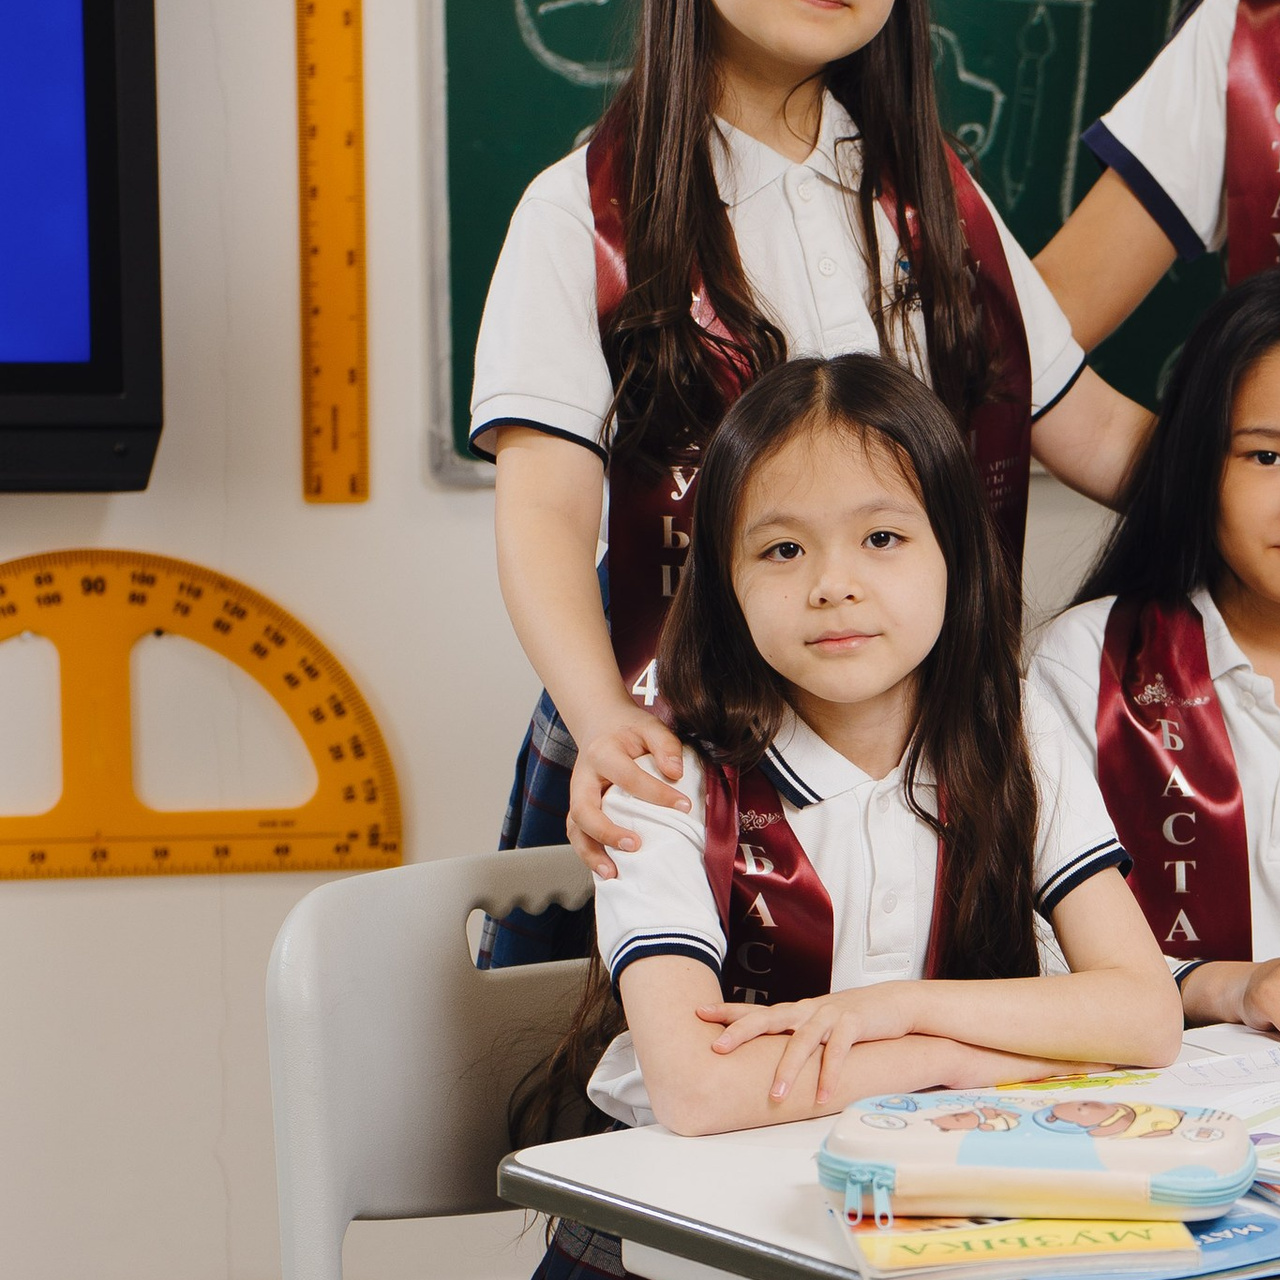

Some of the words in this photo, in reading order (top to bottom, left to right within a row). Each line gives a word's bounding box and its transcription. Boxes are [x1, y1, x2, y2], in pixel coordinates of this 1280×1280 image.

[81, 575, 106, 596] 90
[1155, 718, 1201, 962] БАСТА
[901, 1223, 1153, 1258] МУЗЫКА
